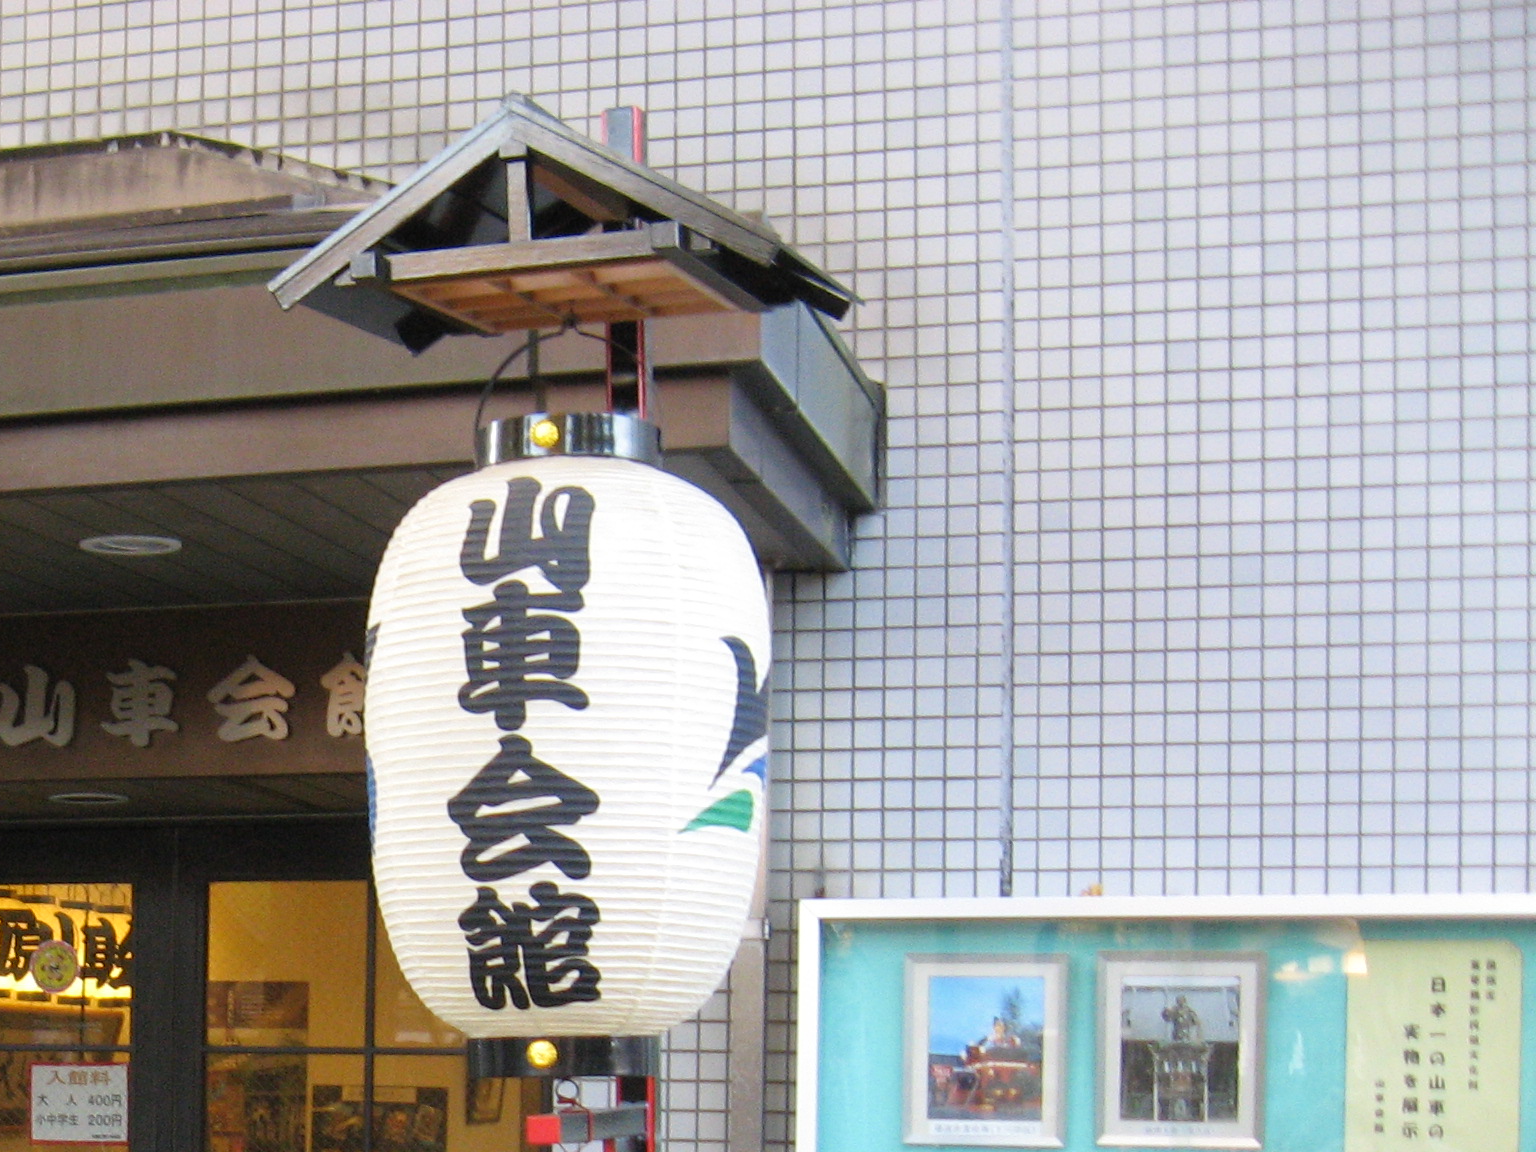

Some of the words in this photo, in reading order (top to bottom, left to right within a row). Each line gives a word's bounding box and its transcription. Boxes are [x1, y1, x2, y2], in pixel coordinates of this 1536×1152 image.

[446, 476, 602, 1011] 山車会館
[46, 1070, 112, 1086] 入館料
[1402, 1023, 1420, 1140] 実物を展示
[1428, 976, 1447, 1140] 日本一の山車の
[37, 1111, 80, 1126] 小中学生
[87, 1112, 122, 1127] 200円
[87, 1094, 122, 1107] 400円
